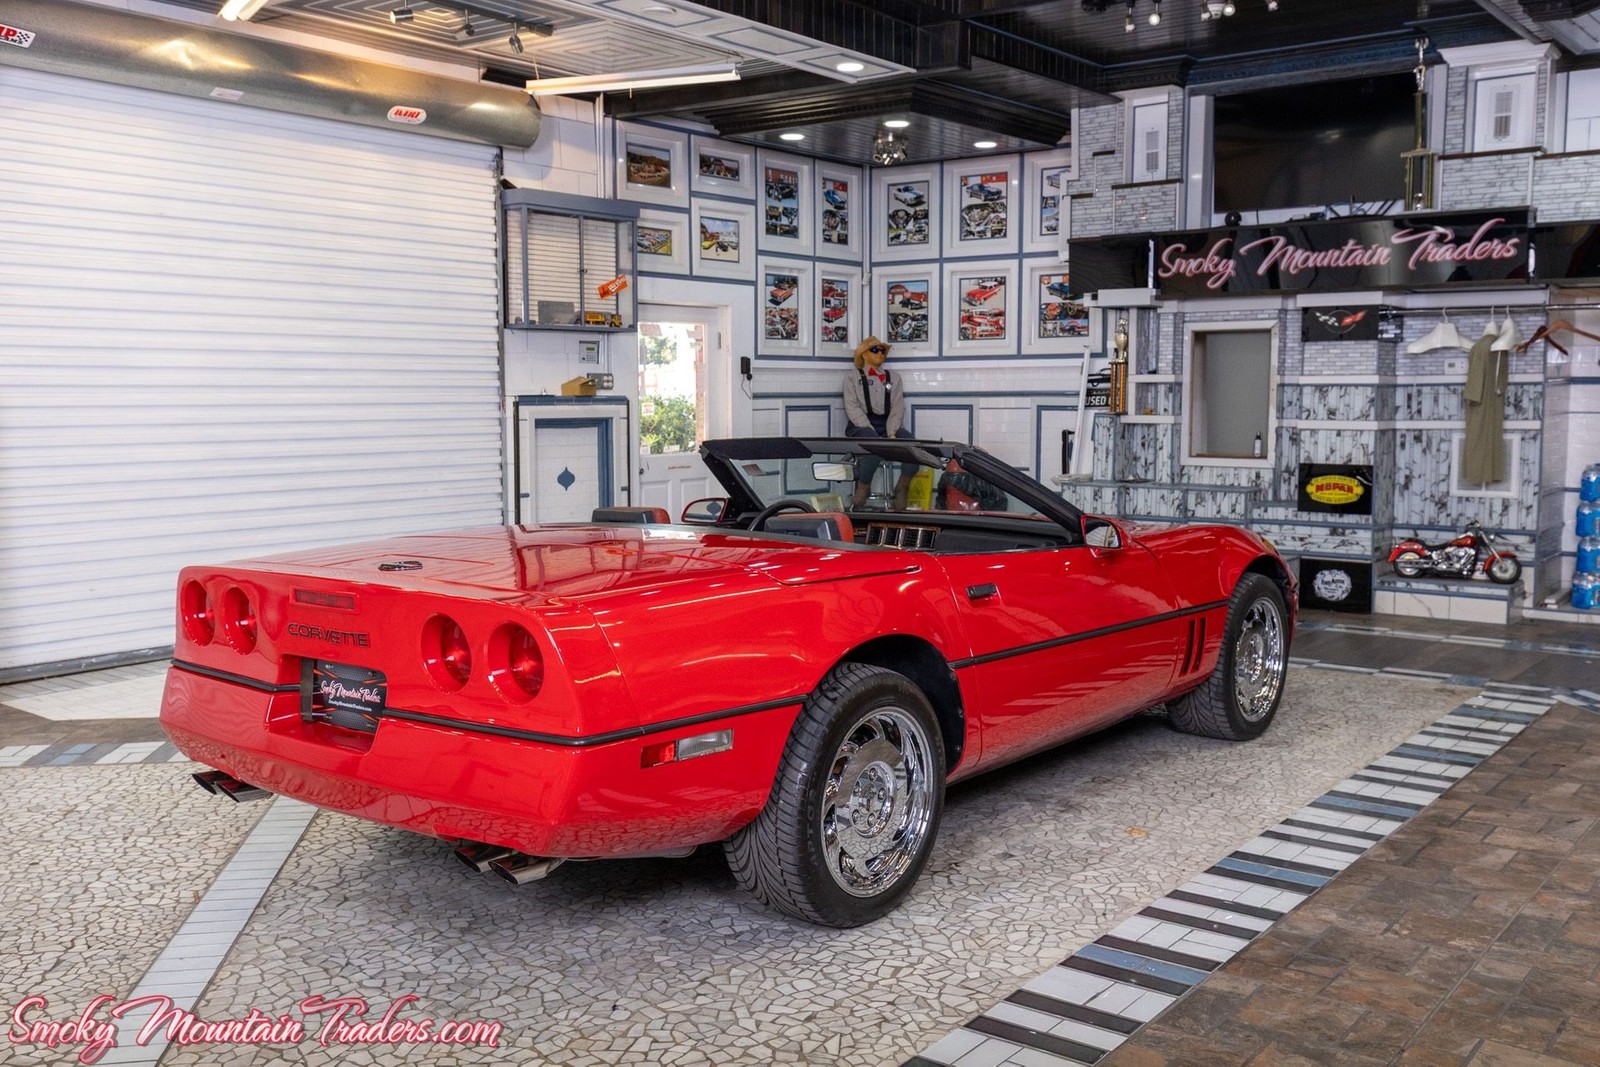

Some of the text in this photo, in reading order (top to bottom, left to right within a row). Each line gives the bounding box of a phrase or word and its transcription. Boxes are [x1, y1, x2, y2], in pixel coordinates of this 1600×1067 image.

[1158, 218, 1521, 289] Smoky Mountain Traders
[1315, 482, 1354, 494] MOPAR
[288, 623, 369, 647] CORVETTE
